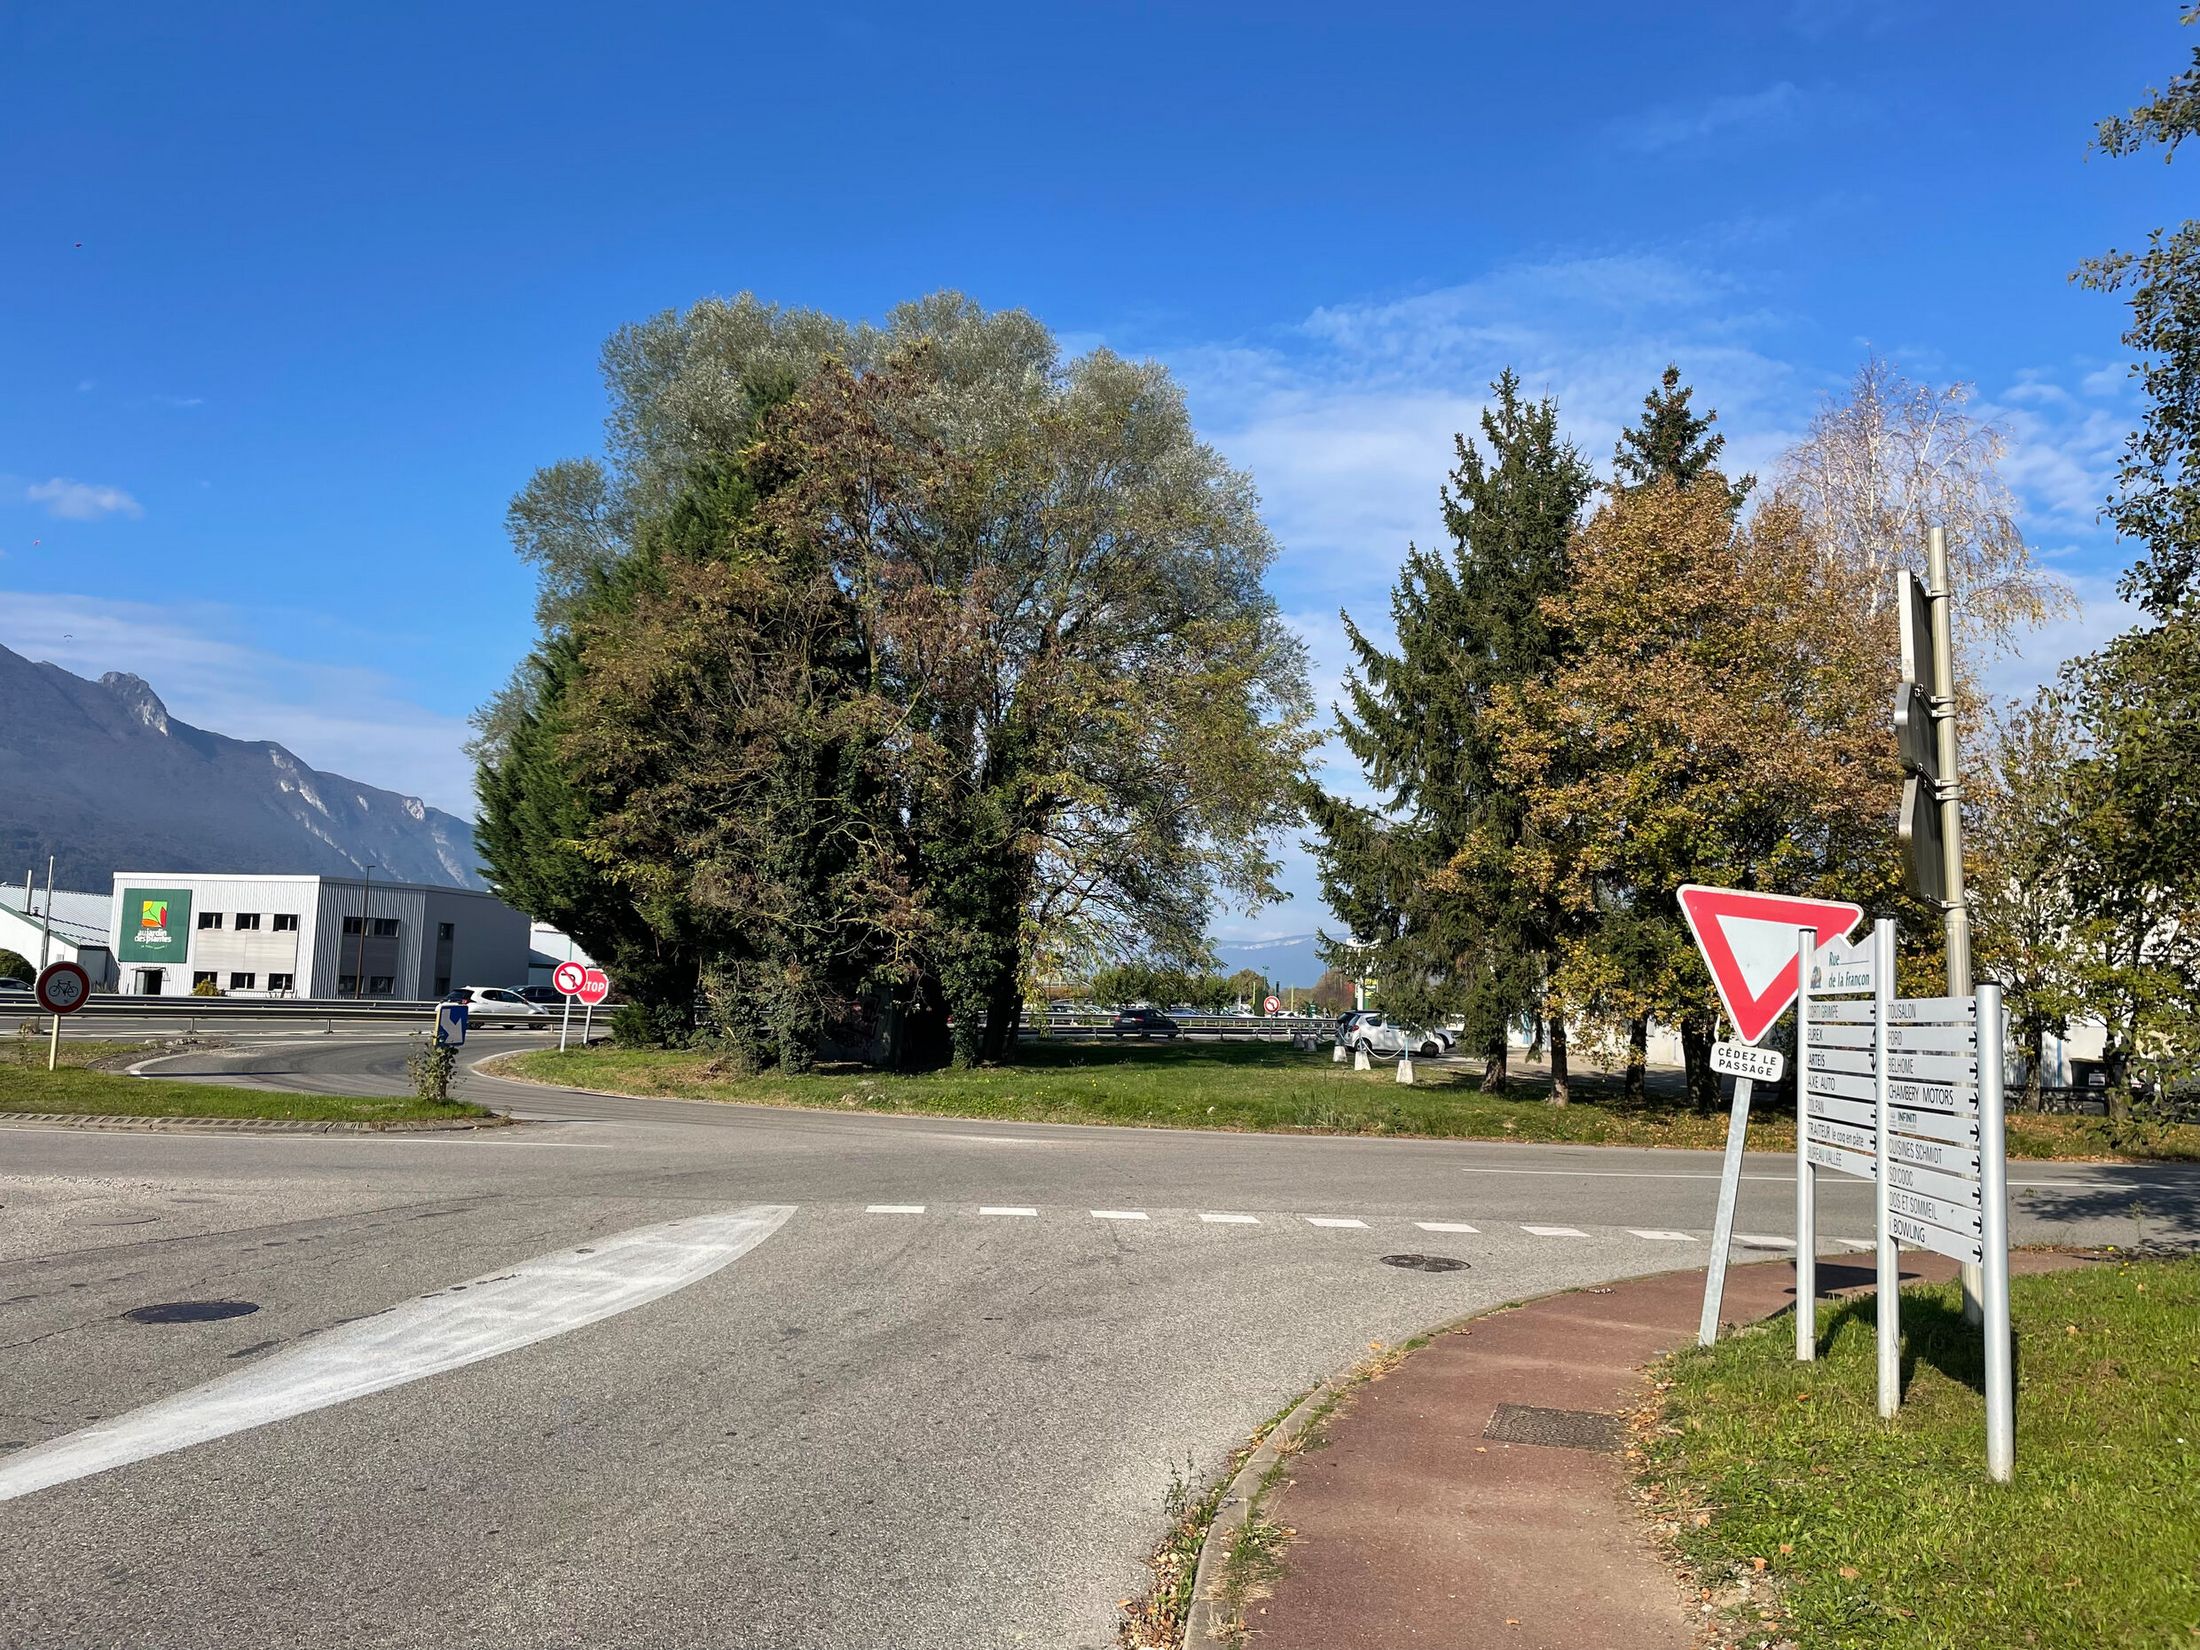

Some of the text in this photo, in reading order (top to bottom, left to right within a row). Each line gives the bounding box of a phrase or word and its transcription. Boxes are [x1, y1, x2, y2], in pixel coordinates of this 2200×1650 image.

[1828, 951, 1840, 967] Rue
[1828, 971, 1870, 988] de la Françon
[1888, 1003, 1916, 1019] TOUSALON
[1808, 1028, 1823, 1041] EUREX
[1888, 1030, 1902, 1045] FORD
[1718, 1047, 1777, 1066] CÉDEZ LE
[1718, 1059, 1773, 1076] PASSAGE
[1888, 1057, 1914, 1074] BELHOME
[1808, 1074, 1835, 1091] AXE AUTO
[1888, 1084, 1954, 1105] CHAMBERY MOTORS
[1898, 1111, 1917, 1123] INFINITI
[1807, 1122, 1830, 1140] TRAITEUR
[1832, 1127, 1836, 1140] le
[1837, 1131, 1845, 1144] coq
[1846, 1134, 1852, 1144] en
[1807, 1145, 1825, 1162] BUREAU
[1889, 1138, 1942, 1164] CUISINES SCHMIDT
[1889, 1191, 1938, 1220] DOS ET SOMMEIL
[1893, 1218, 1926, 1243] BOWLING
